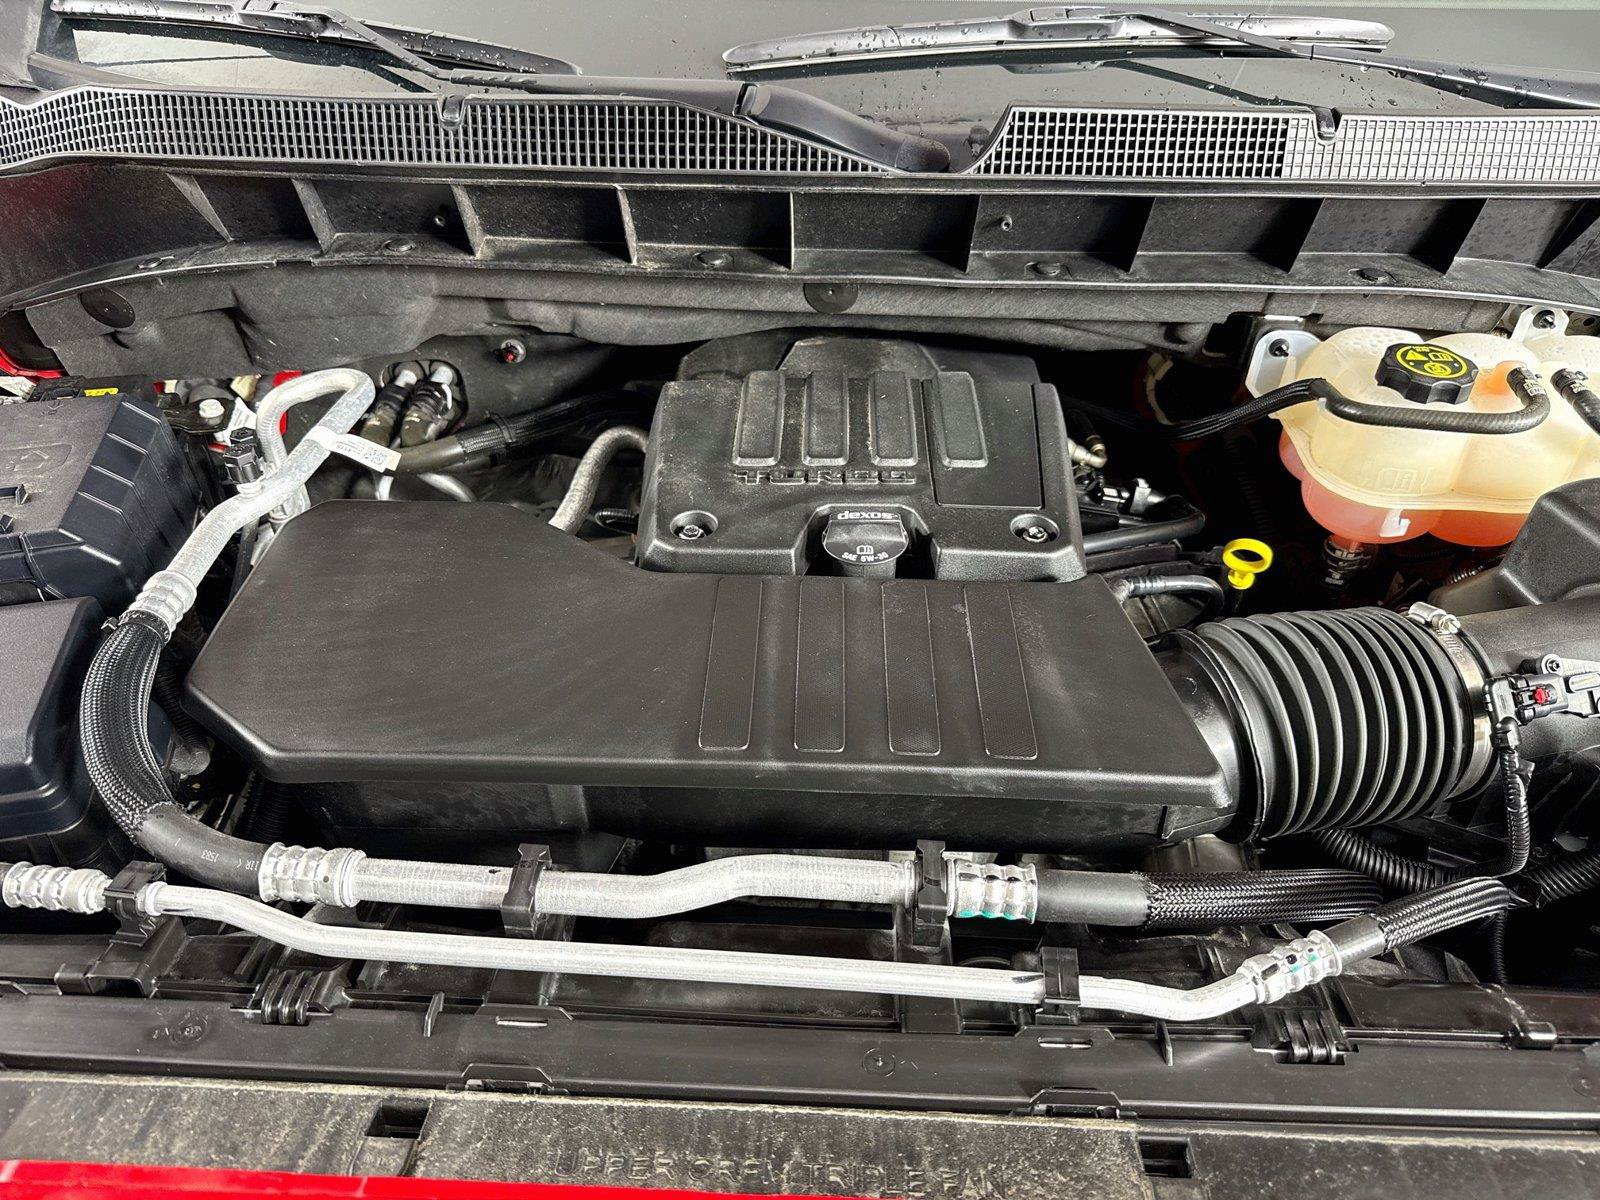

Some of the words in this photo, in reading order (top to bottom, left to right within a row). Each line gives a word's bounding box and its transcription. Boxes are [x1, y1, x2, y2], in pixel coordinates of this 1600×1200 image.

[837, 510, 893, 520] dexos
[841, 551, 858, 561] SAE
[555, 1149, 675, 1181] UPPER
[938, 1166, 1006, 1200] FAN
